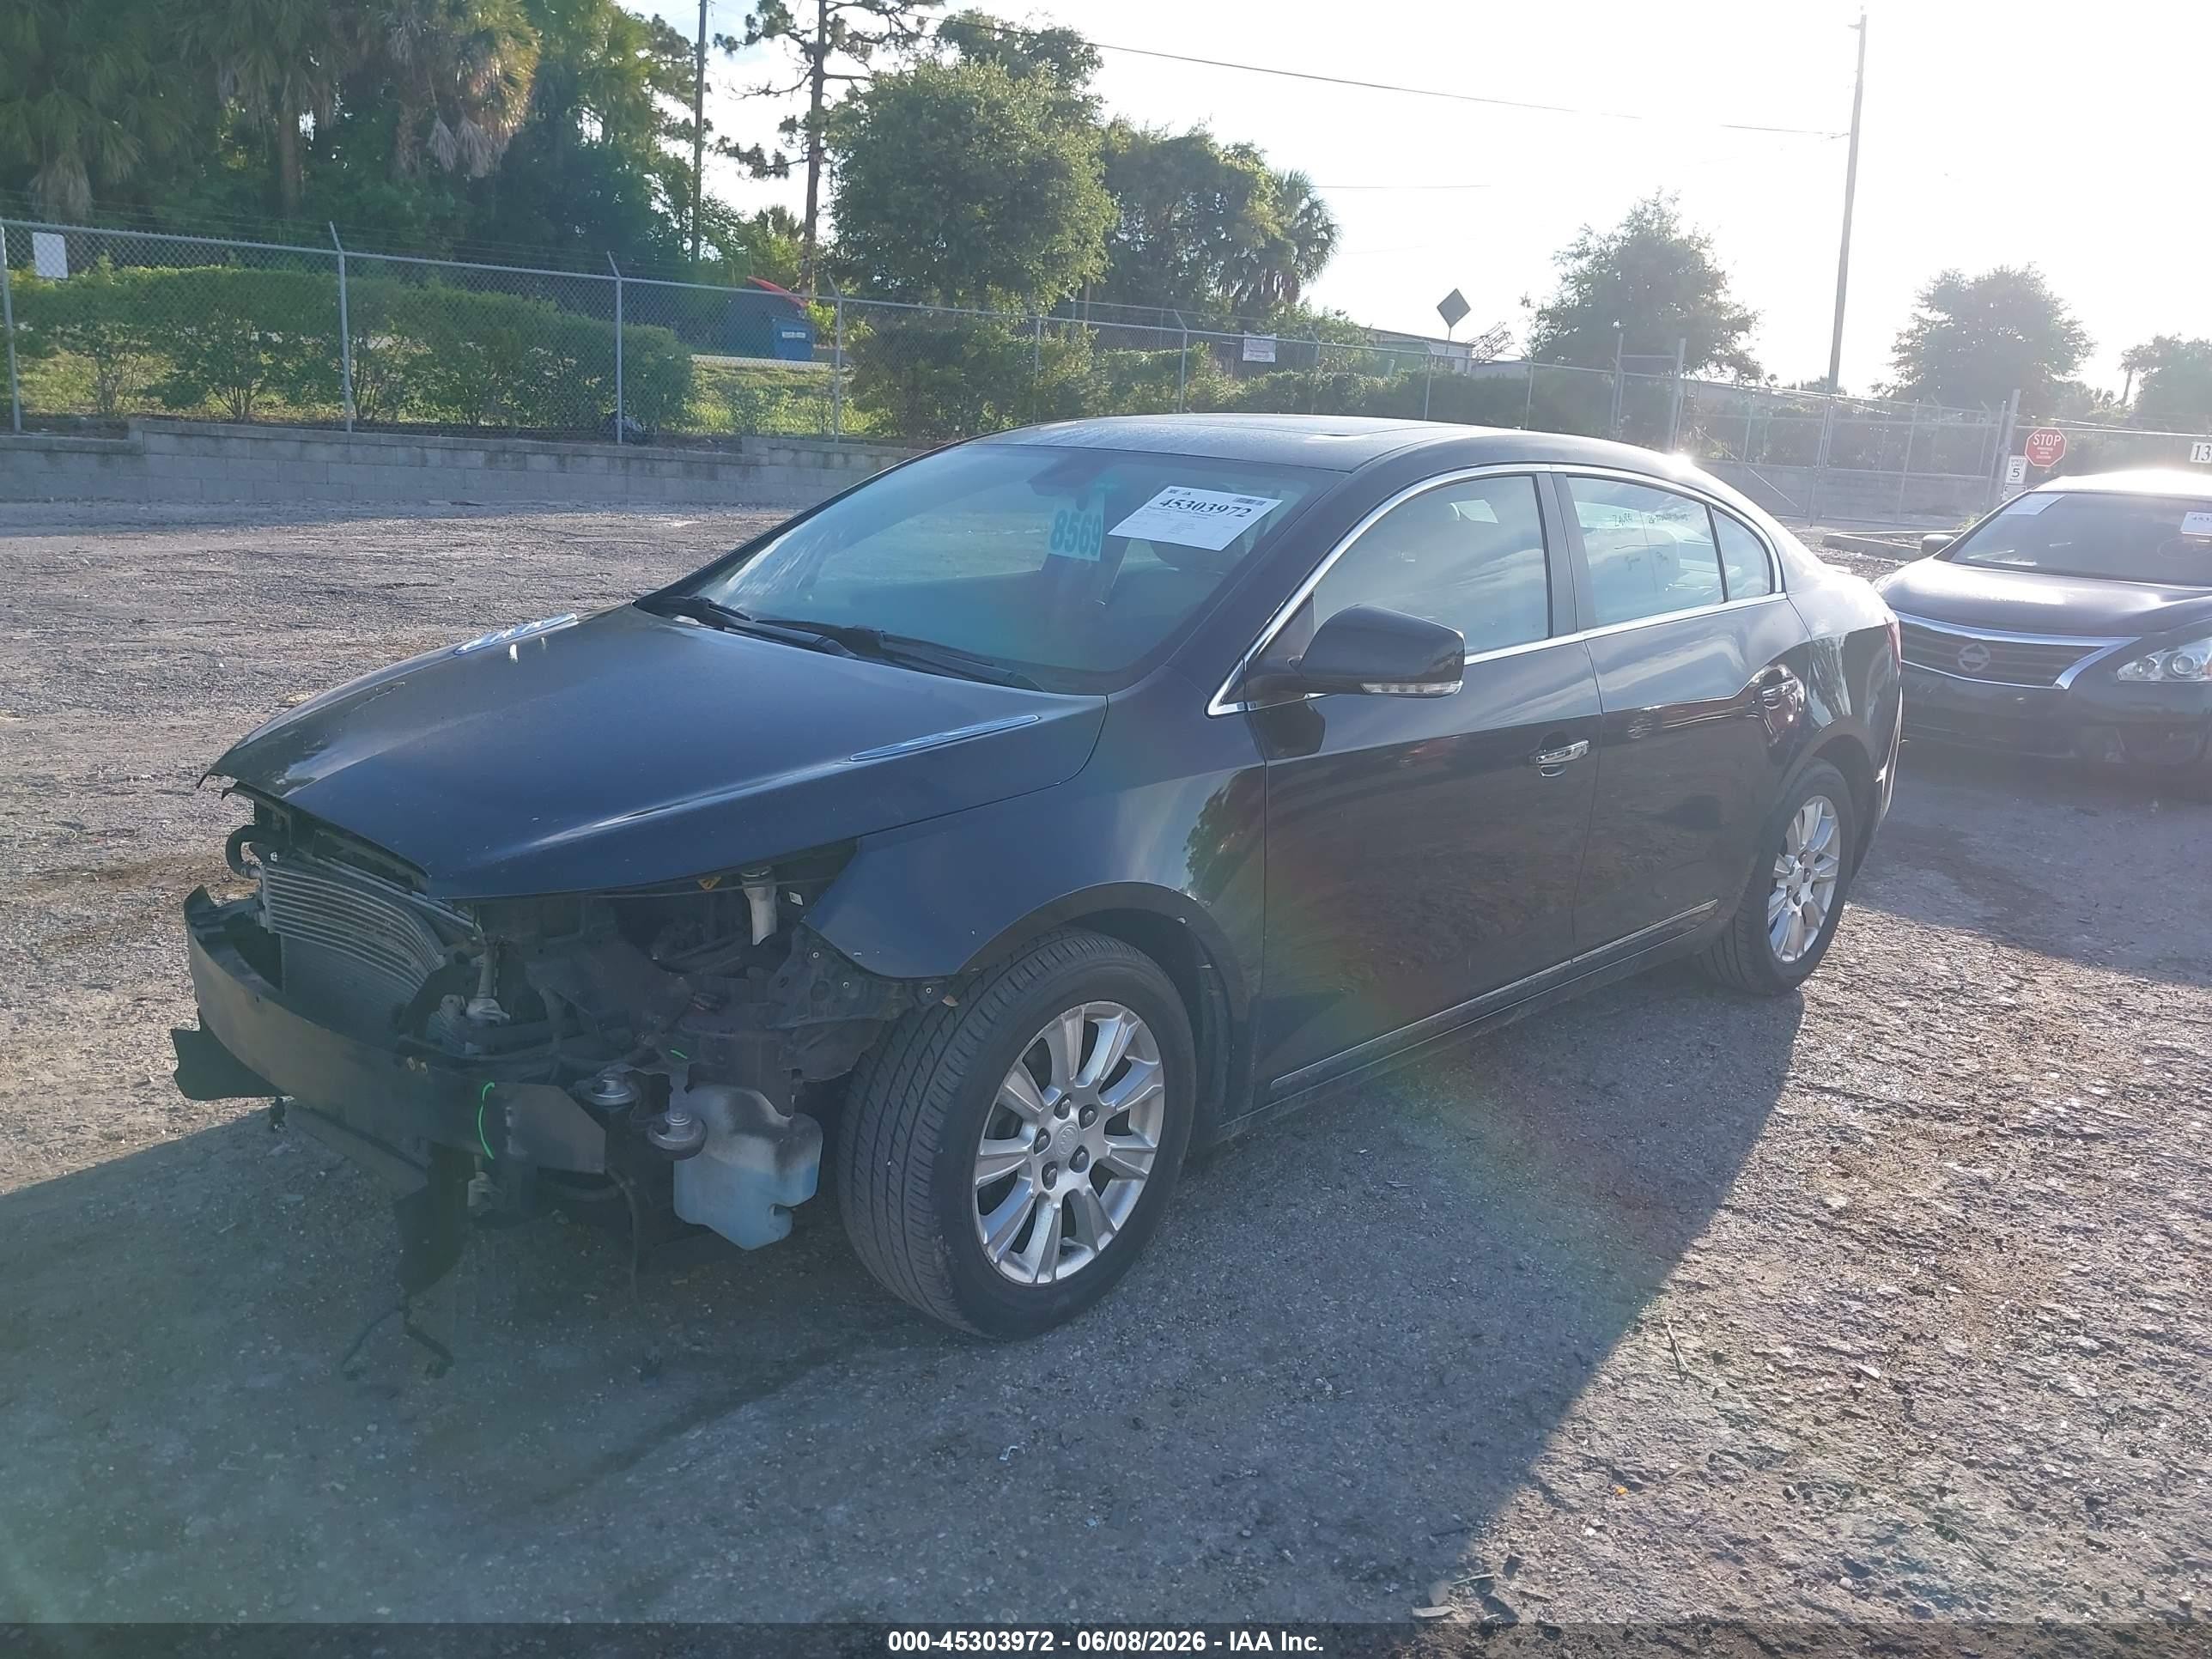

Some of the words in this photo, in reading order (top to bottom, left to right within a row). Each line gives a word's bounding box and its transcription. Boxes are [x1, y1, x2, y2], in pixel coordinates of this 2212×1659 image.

[2033, 434, 2062, 447] STOP
[2011, 468, 2021, 477] 5
[1159, 497, 1253, 518] 45303972
[1050, 509, 1102, 556] 8569
